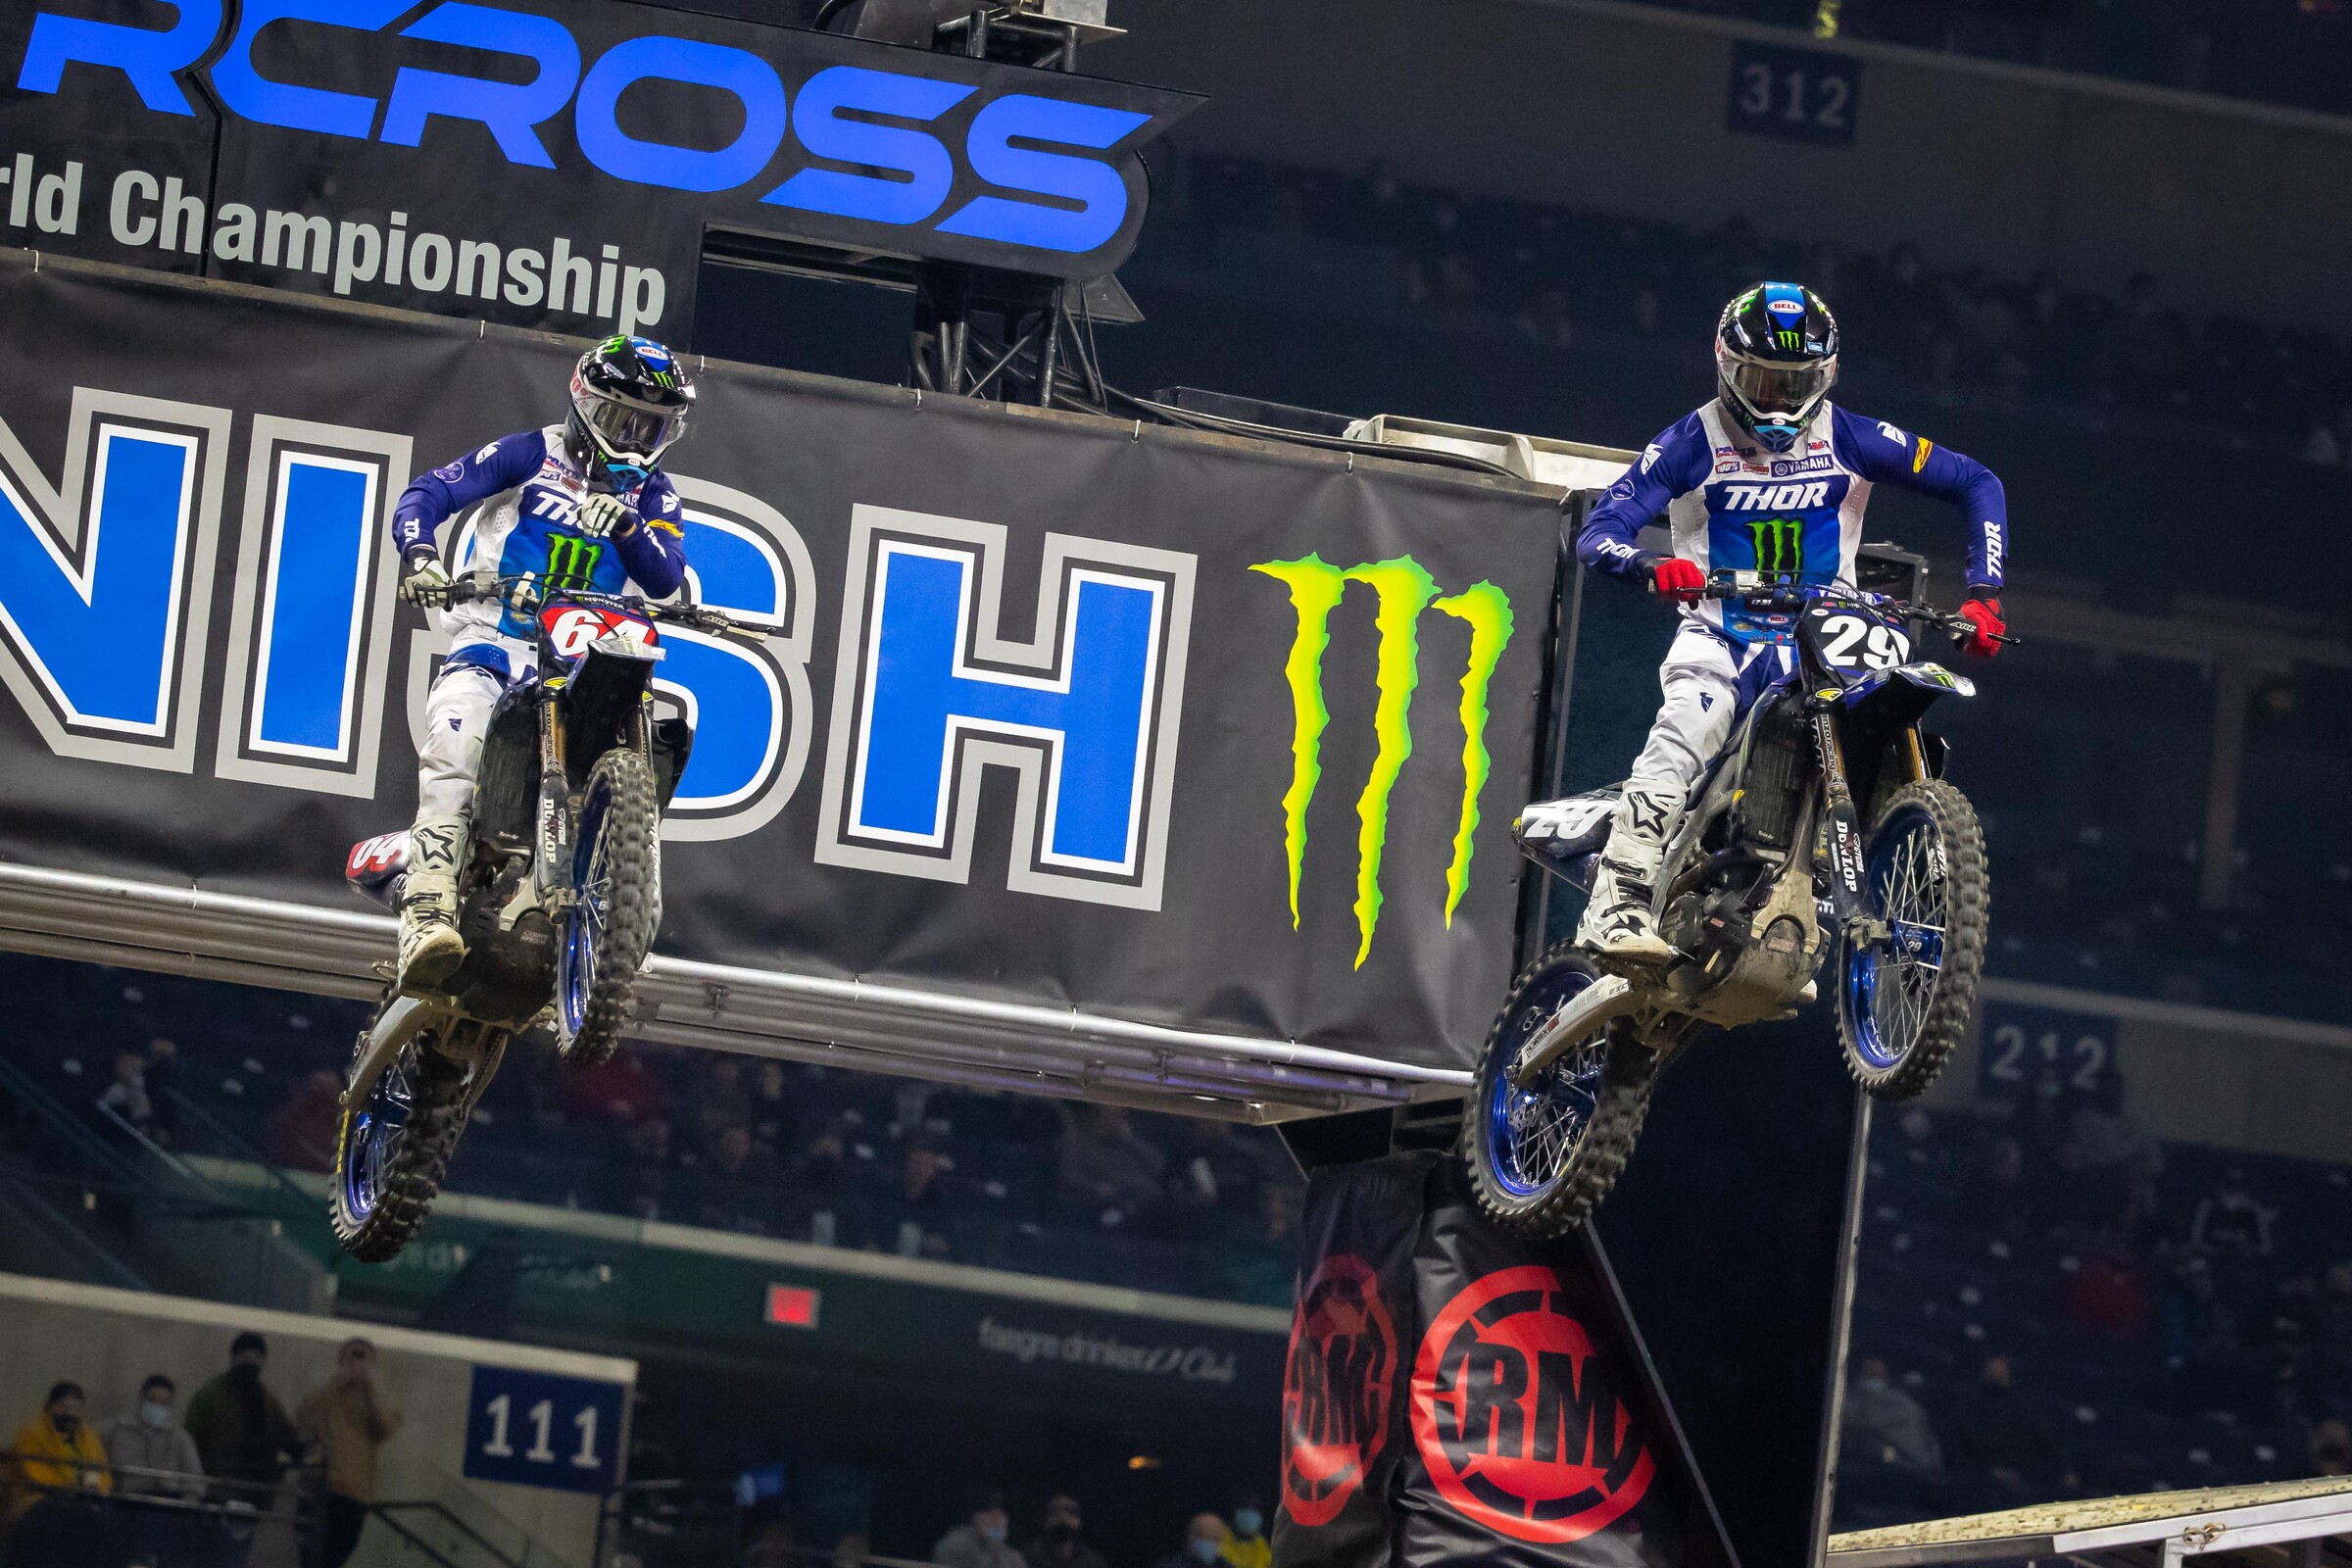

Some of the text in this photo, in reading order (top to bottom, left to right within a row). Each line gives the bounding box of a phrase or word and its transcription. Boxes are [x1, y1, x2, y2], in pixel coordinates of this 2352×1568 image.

[1740, 63, 1849, 127] 312
[0, 152, 665, 334] ld Championship
[641, 347, 663, 358] BELL
[1717, 461, 1739, 474] 100%
[1788, 457, 1833, 473] YAMAHA
[1725, 481, 1831, 510] THOR
[1984, 520, 2003, 579] THOR
[584, 596, 625, 611] MONSTER
[550, 609, 651, 657] 64
[1820, 614, 1910, 671] 29
[1468, 1340, 1622, 1469] RM
[482, 1393, 602, 1470] 111
